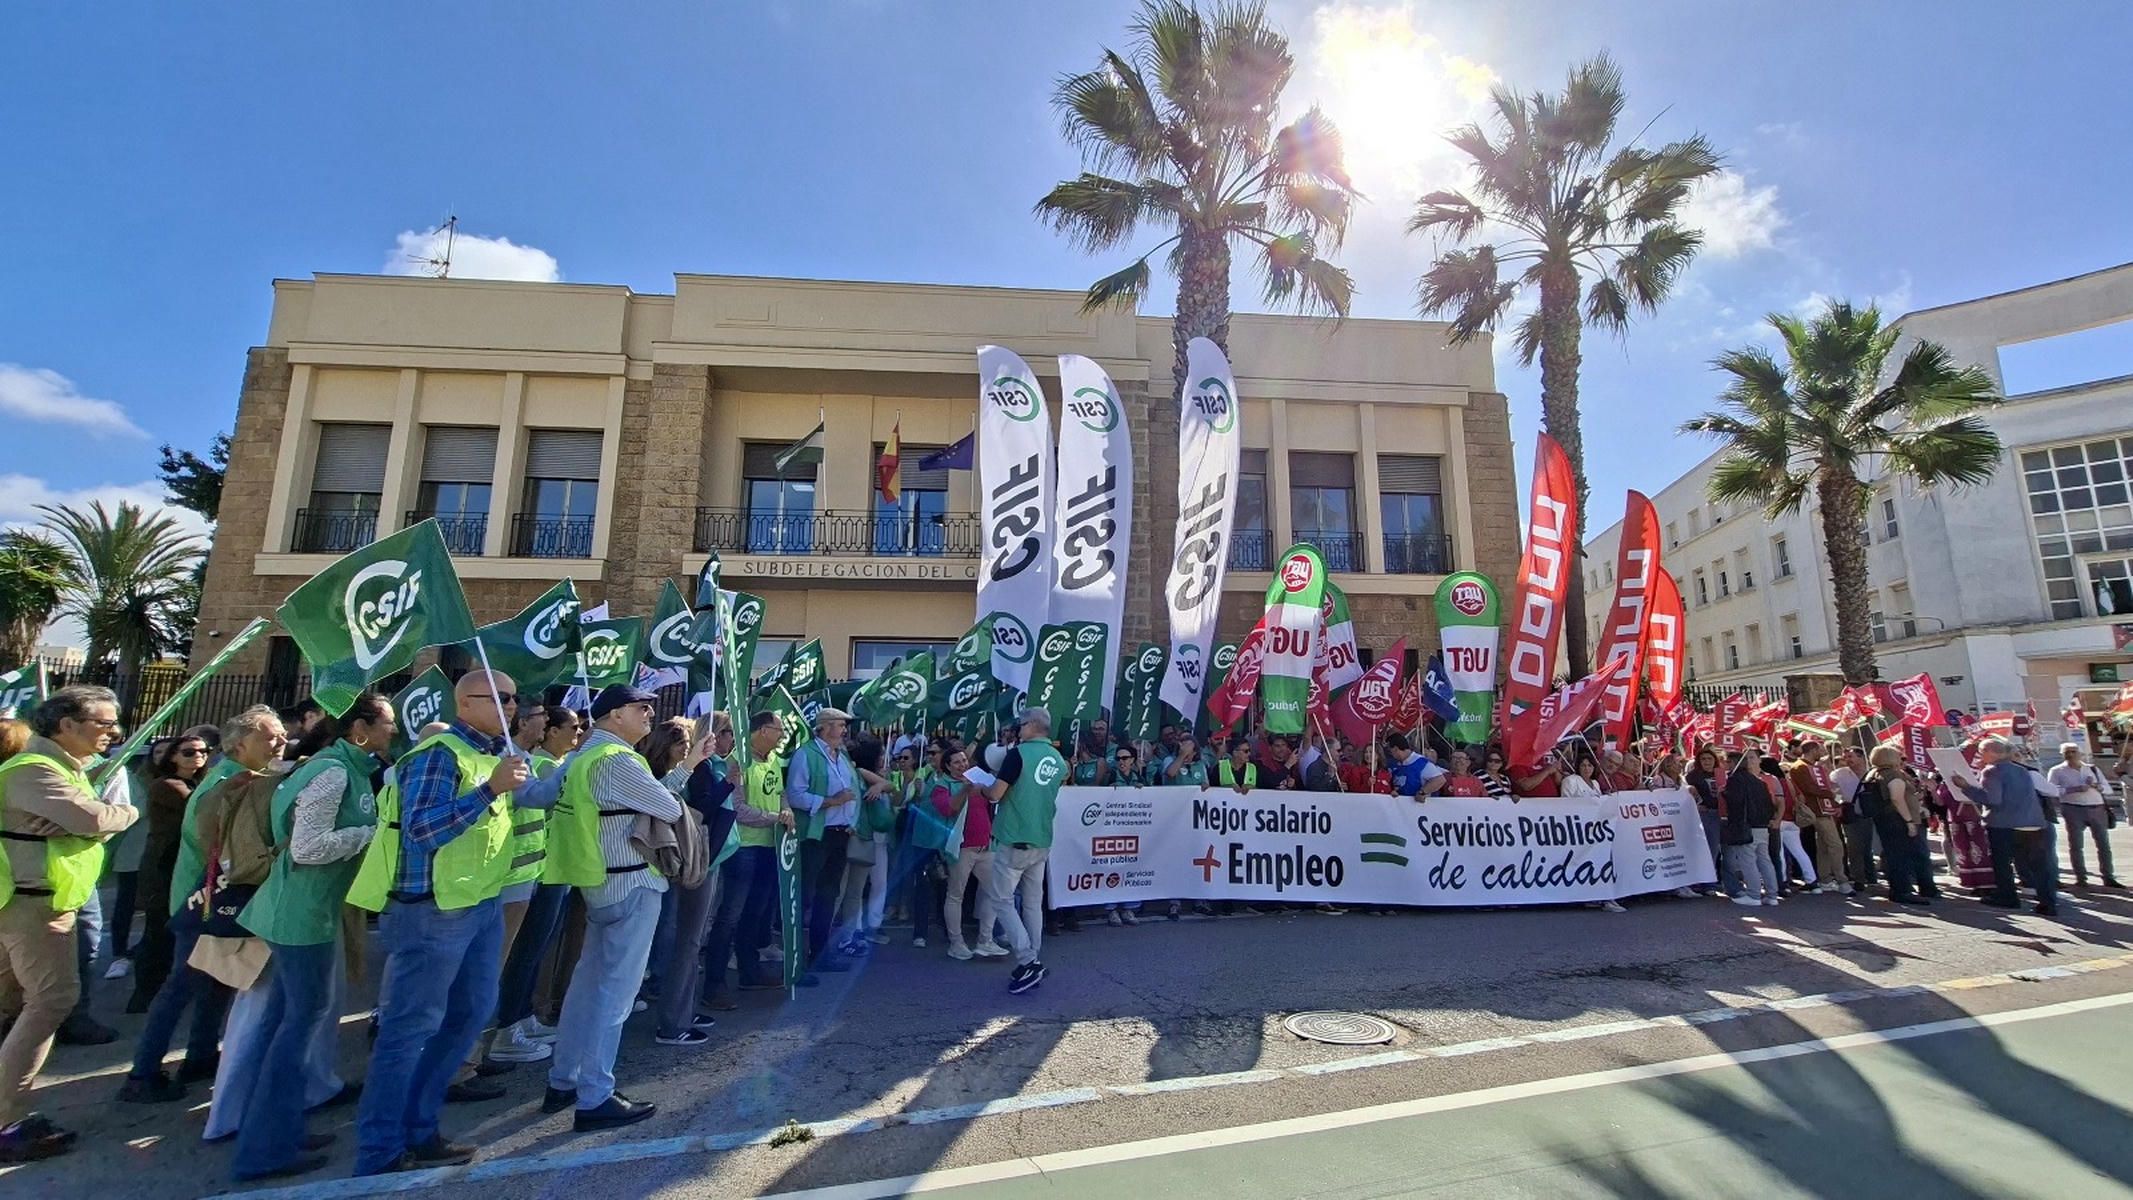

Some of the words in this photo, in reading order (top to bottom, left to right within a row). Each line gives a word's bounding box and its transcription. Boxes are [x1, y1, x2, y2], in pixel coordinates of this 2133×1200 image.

[743, 561, 908, 578] SUBDELEGACION
[918, 564, 953, 578] DEL
[358, 568, 422, 640] CSIF
[587, 645, 628, 666] CSIF
[0, 686, 37, 708] IF
[1074, 654, 1093, 715] CSIF
[1359, 680, 1392, 699] UGT
[1139, 677, 1155, 736] CSIF
[1723, 705, 1736, 745] CCO
[1813, 767, 1832, 808] CCO
[1193, 800, 1248, 835] Mejor
[1255, 804, 1332, 834] salario
[1620, 804, 1646, 819] UGT
[1095, 839, 1137, 852] CCOO
[1418, 815, 1515, 847] Servicios
[1518, 815, 1615, 847] Públicos
[1068, 873, 1104, 891] UGT
[1229, 843, 1344, 892] Empleo
[1428, 850, 1467, 890] de
[1481, 850, 1618, 890] calidad
